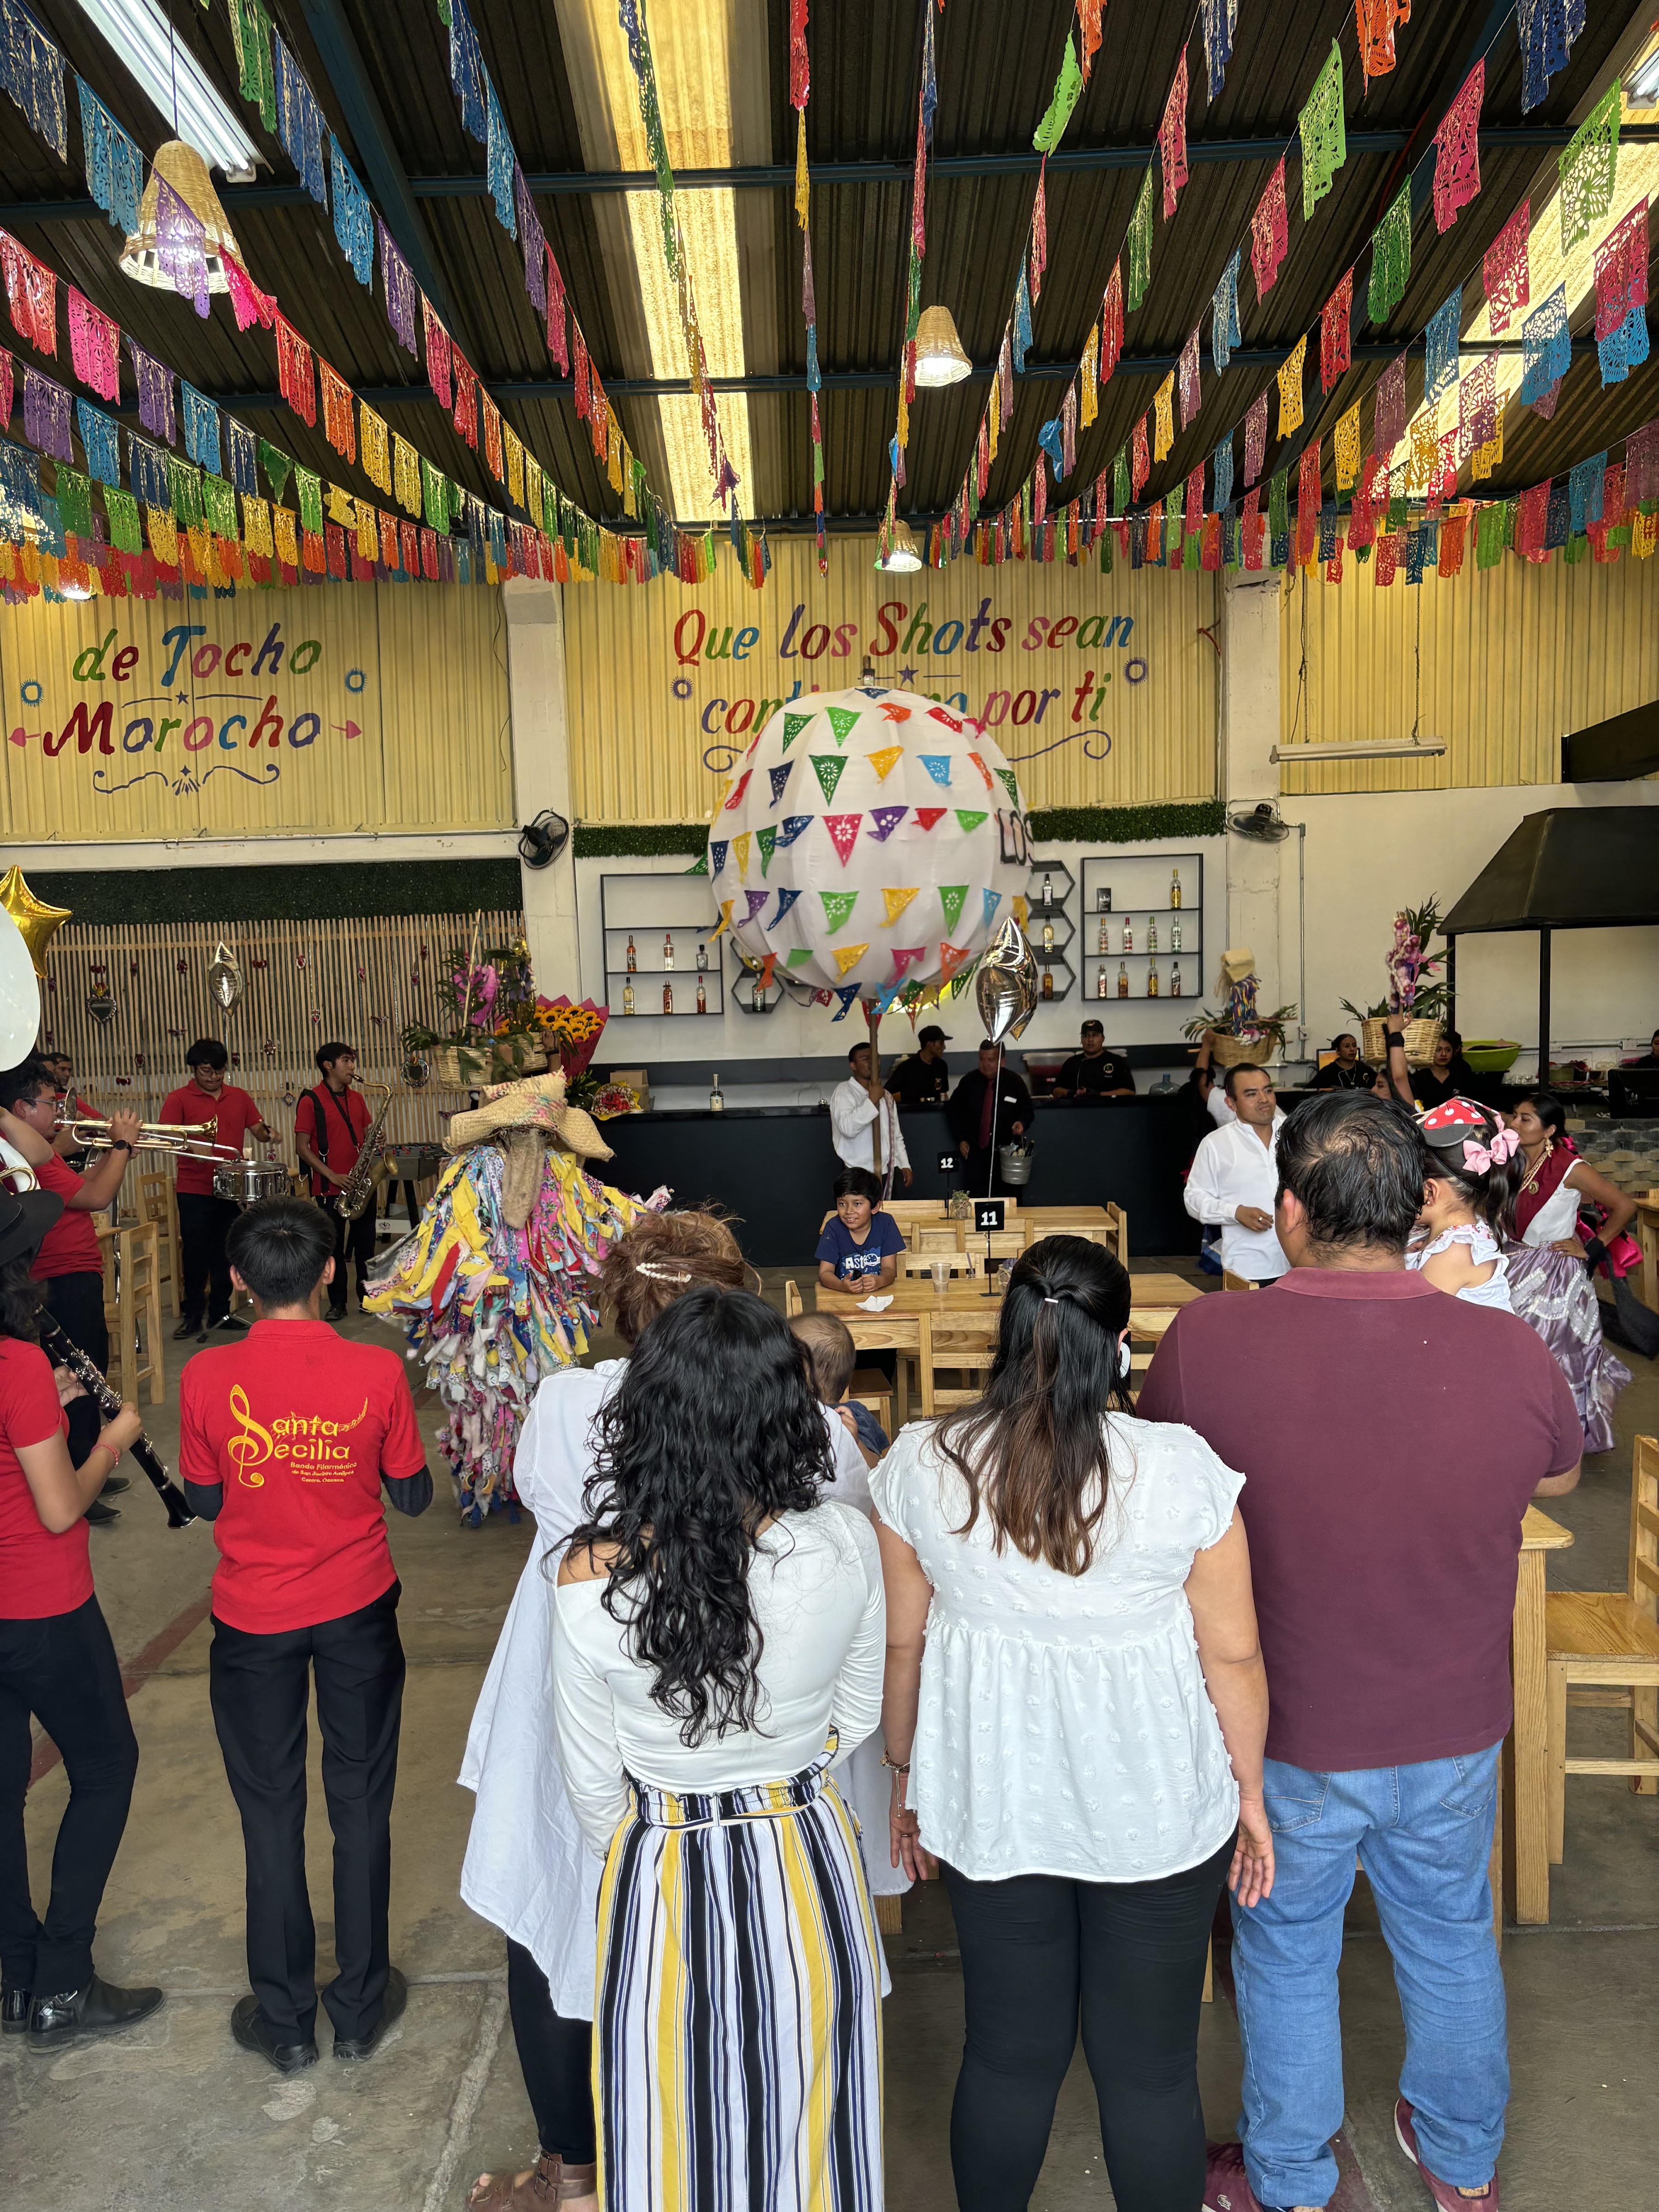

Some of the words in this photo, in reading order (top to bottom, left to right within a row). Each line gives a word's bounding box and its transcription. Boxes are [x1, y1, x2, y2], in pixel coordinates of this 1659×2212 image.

[72, 628, 139, 682] de
[161, 623, 322, 687] Tocho
[673, 609, 759, 666] Que
[779, 603, 858, 661] los
[869, 597, 1012, 657] Shots
[1021, 614, 1135, 651] sean
[43, 694, 321, 757] Morocho
[977, 688, 1061, 727] por
[1071, 670, 1112, 723] ti
[941, 1157, 953, 1169] 12
[980, 1211, 998, 1226] 11
